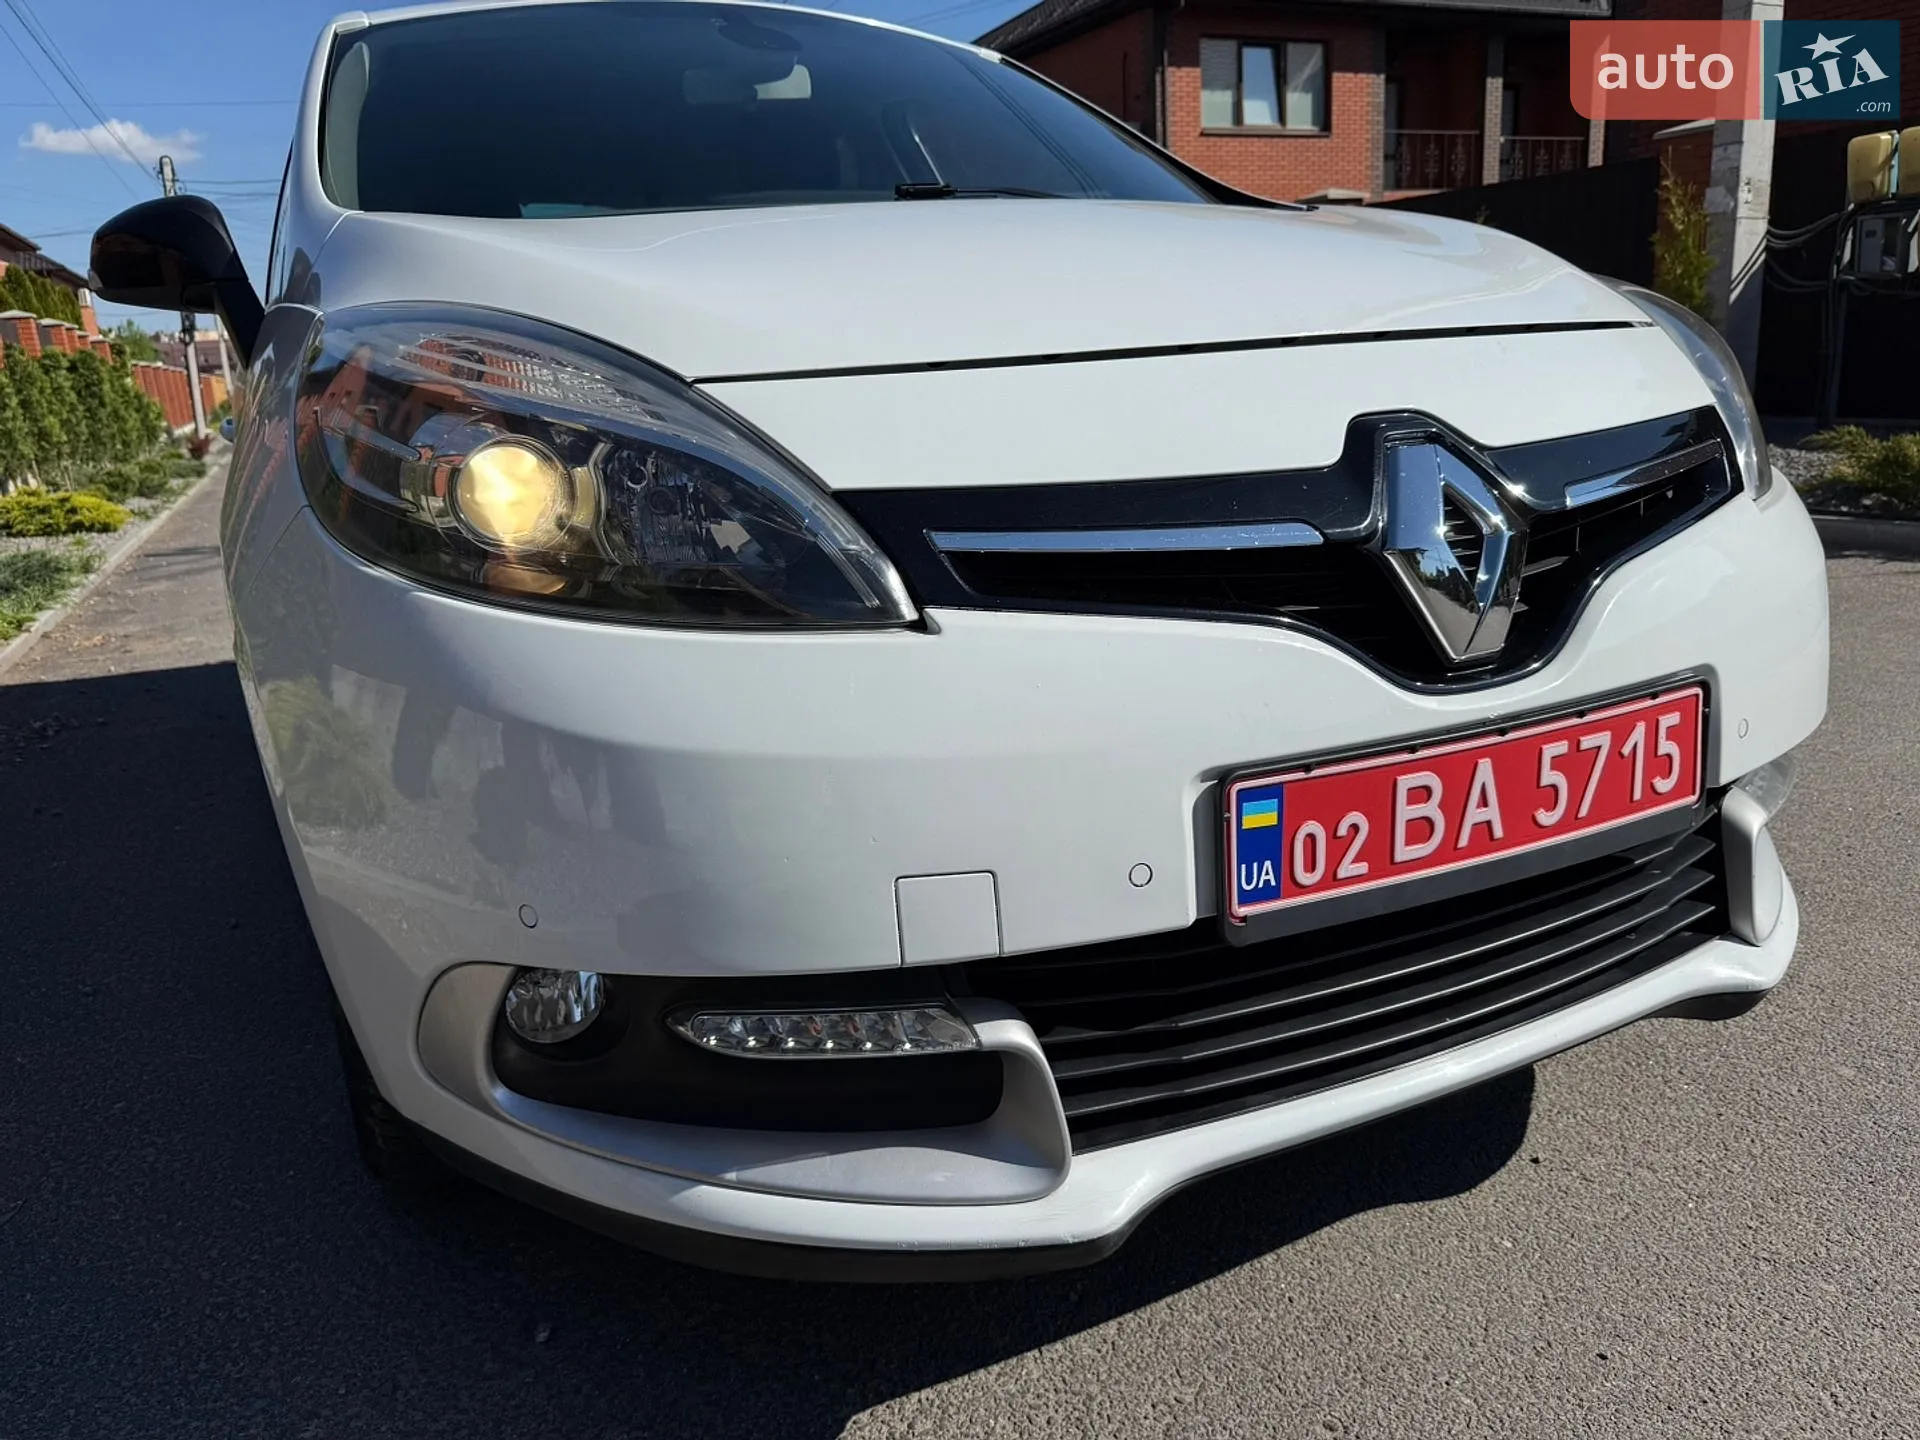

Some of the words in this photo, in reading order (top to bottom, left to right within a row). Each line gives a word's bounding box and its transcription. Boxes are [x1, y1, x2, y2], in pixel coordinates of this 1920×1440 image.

[1292, 811, 1369, 887] 02
[1393, 758, 1504, 863] BA
[1532, 711, 1681, 827] 5715
[1240, 859, 1276, 890] UA
